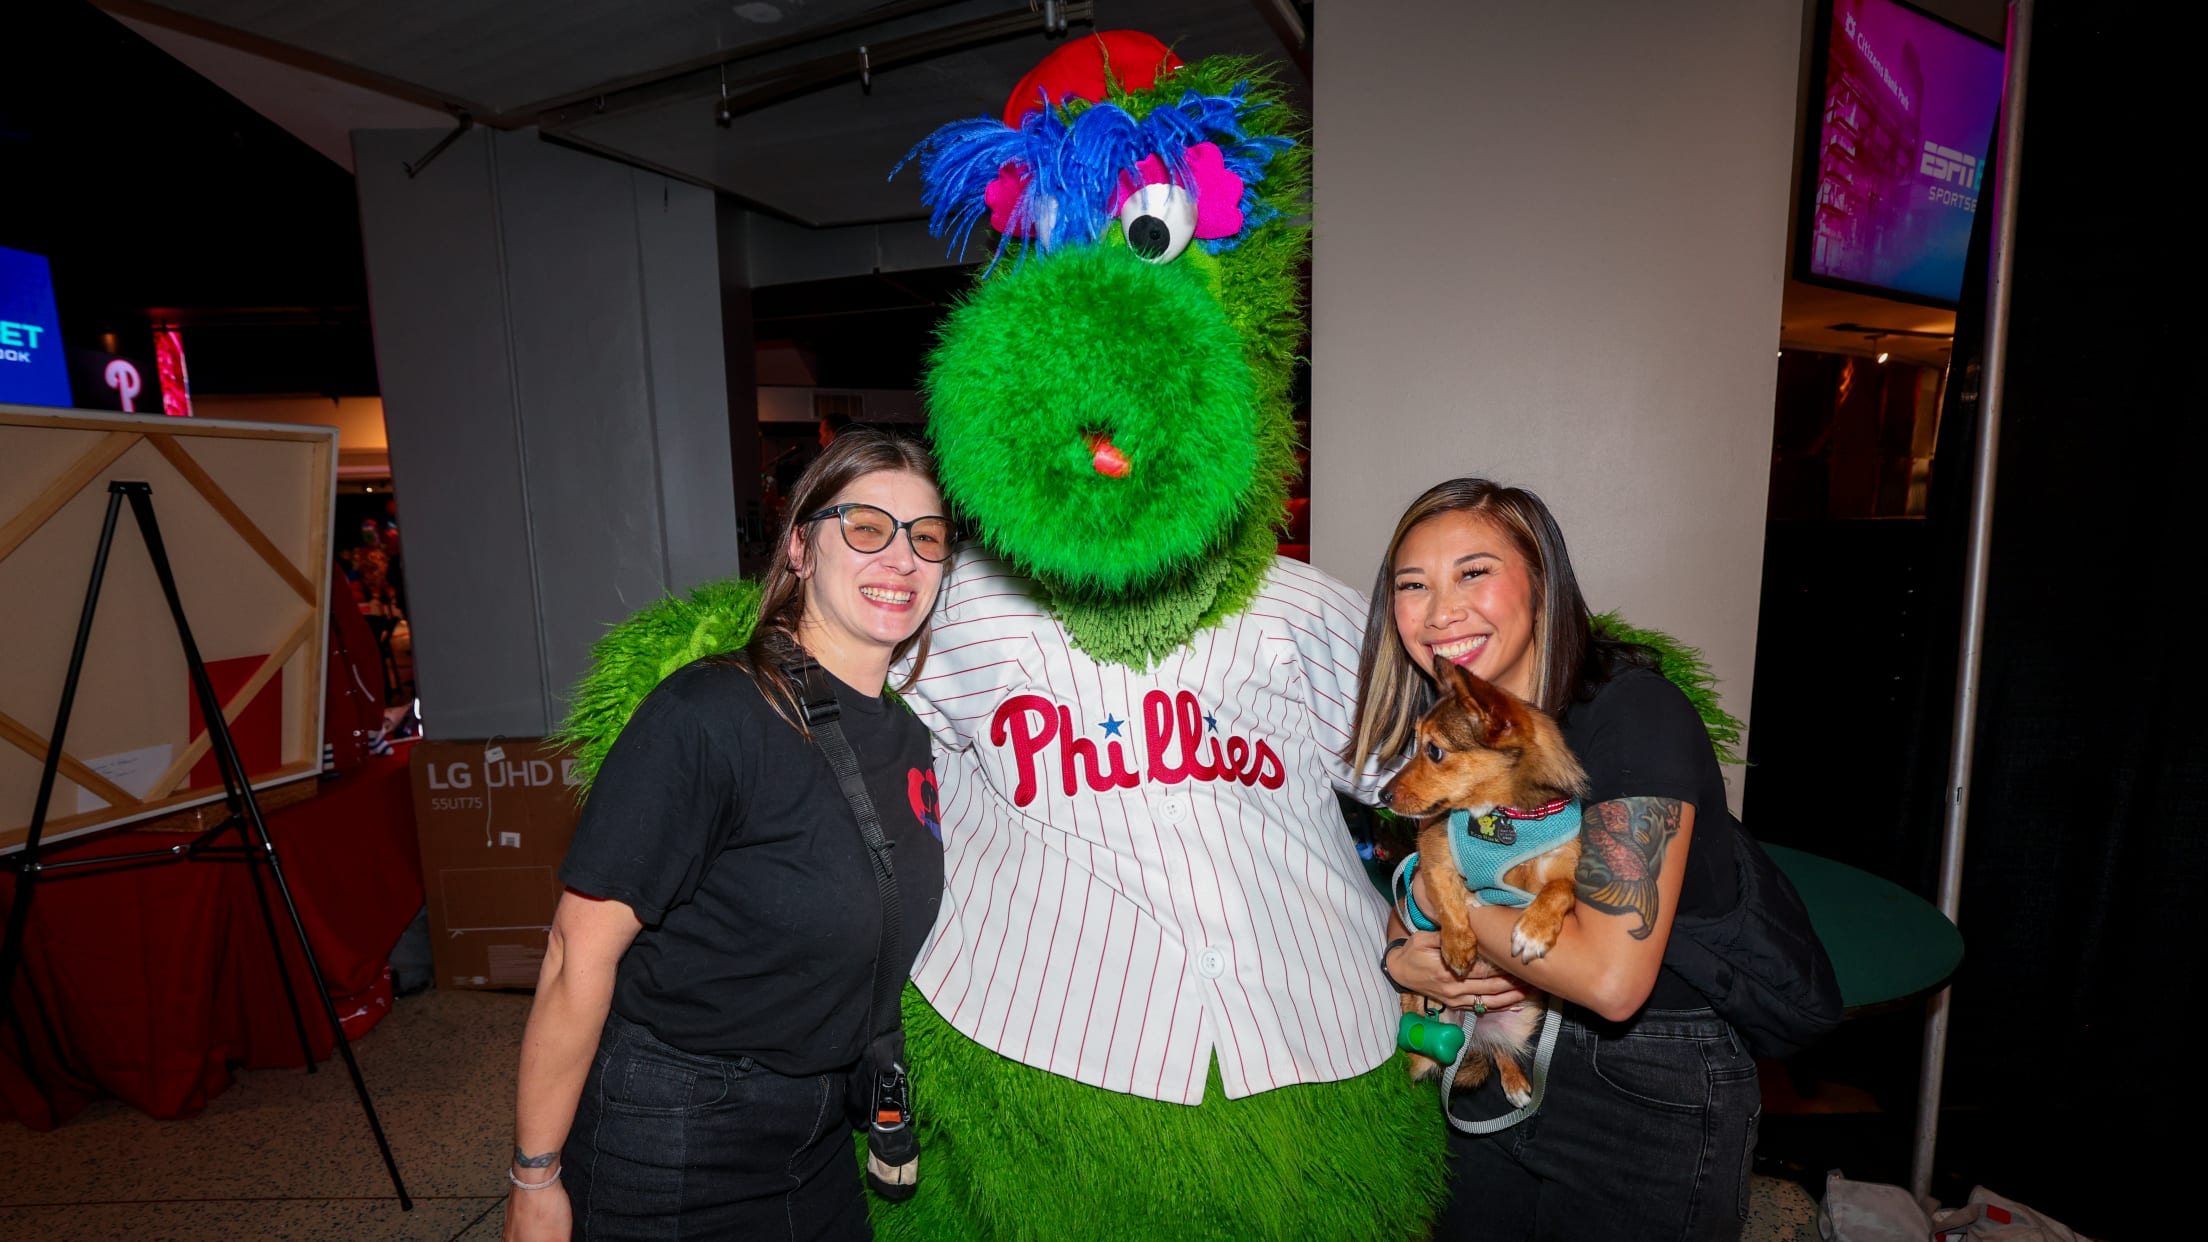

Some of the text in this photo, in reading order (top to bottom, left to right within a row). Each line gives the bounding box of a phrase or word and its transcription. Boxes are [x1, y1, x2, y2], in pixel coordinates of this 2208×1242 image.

[1857, 32, 1910, 112] Citizens Bank Park
[1921, 141, 1975, 187] ESPN
[0, 348, 32, 364] OK
[991, 689, 1286, 808] Phillies
[427, 759, 554, 790] LG UHD
[431, 796, 484, 811] 55UT75
